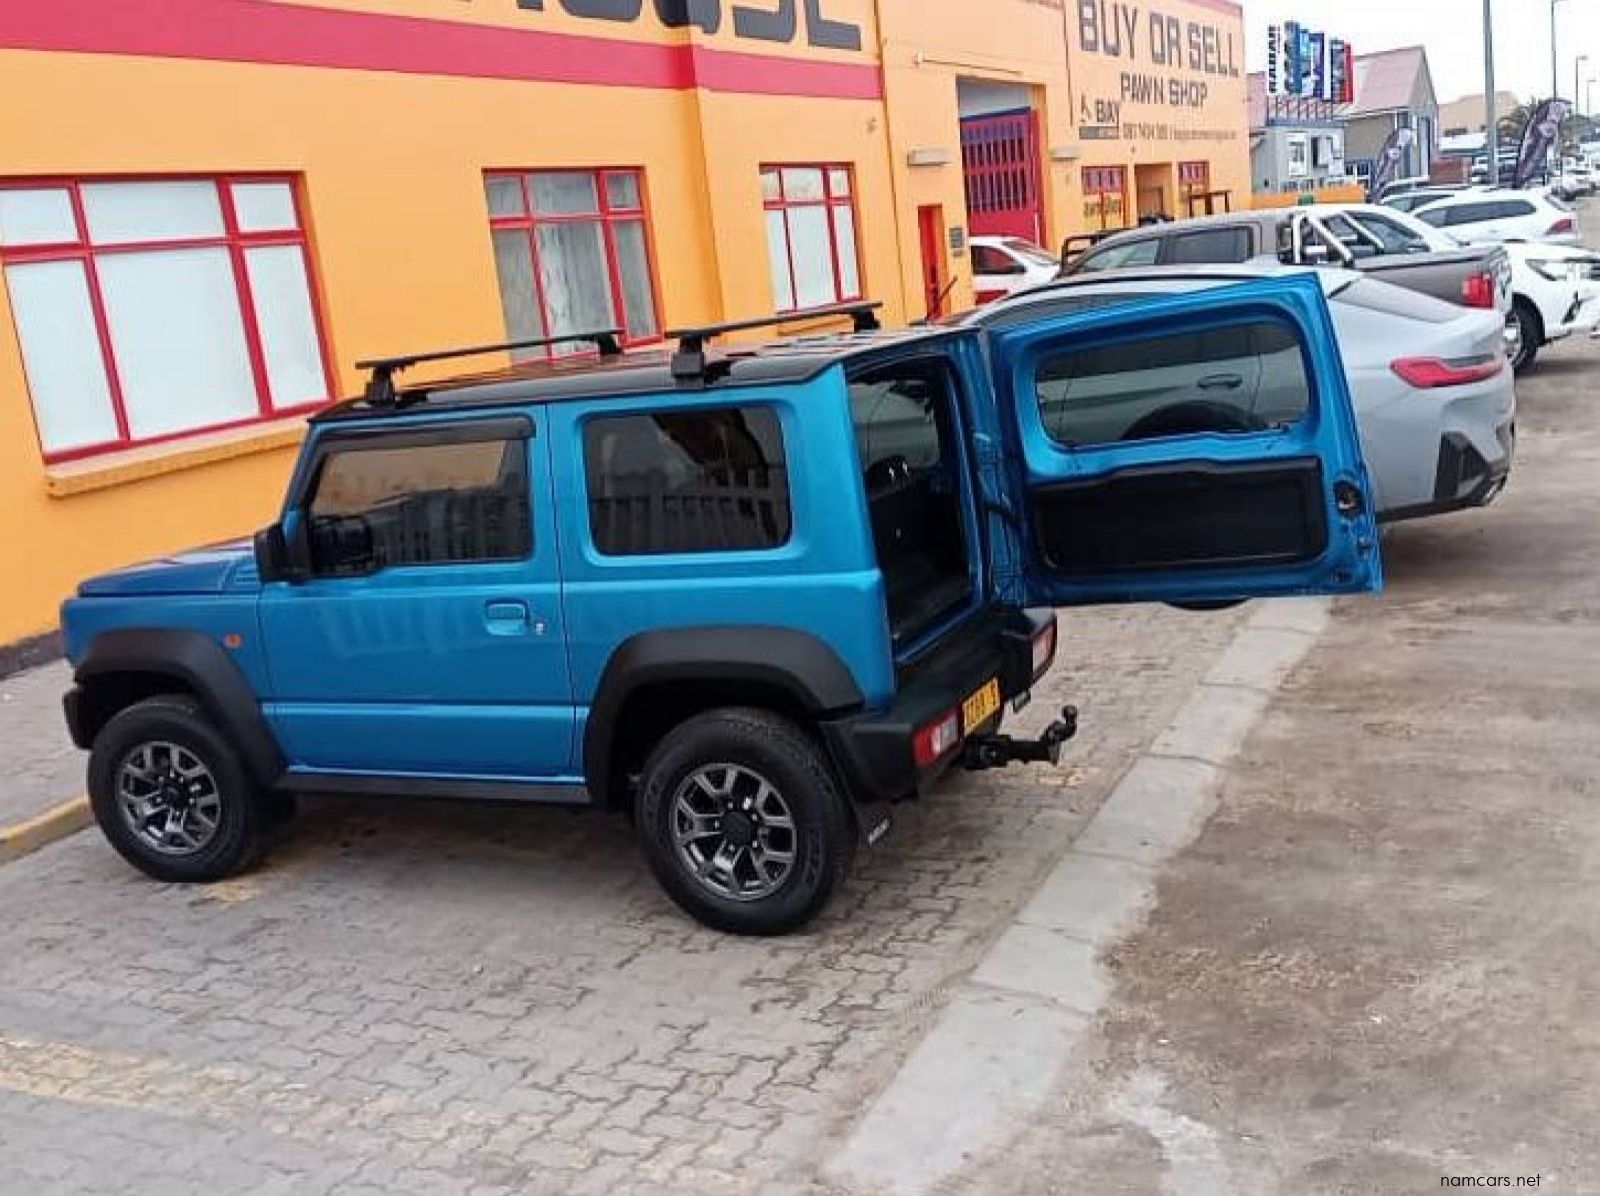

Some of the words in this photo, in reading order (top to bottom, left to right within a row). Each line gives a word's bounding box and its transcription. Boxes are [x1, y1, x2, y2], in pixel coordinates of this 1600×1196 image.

[1078, 0, 1138, 60] BUY
[1150, 12, 1182, 69] OR
[1187, 21, 1240, 77] SELL
[1120, 72, 1165, 105] PAWN
[1169, 77, 1209, 107] SHOP
